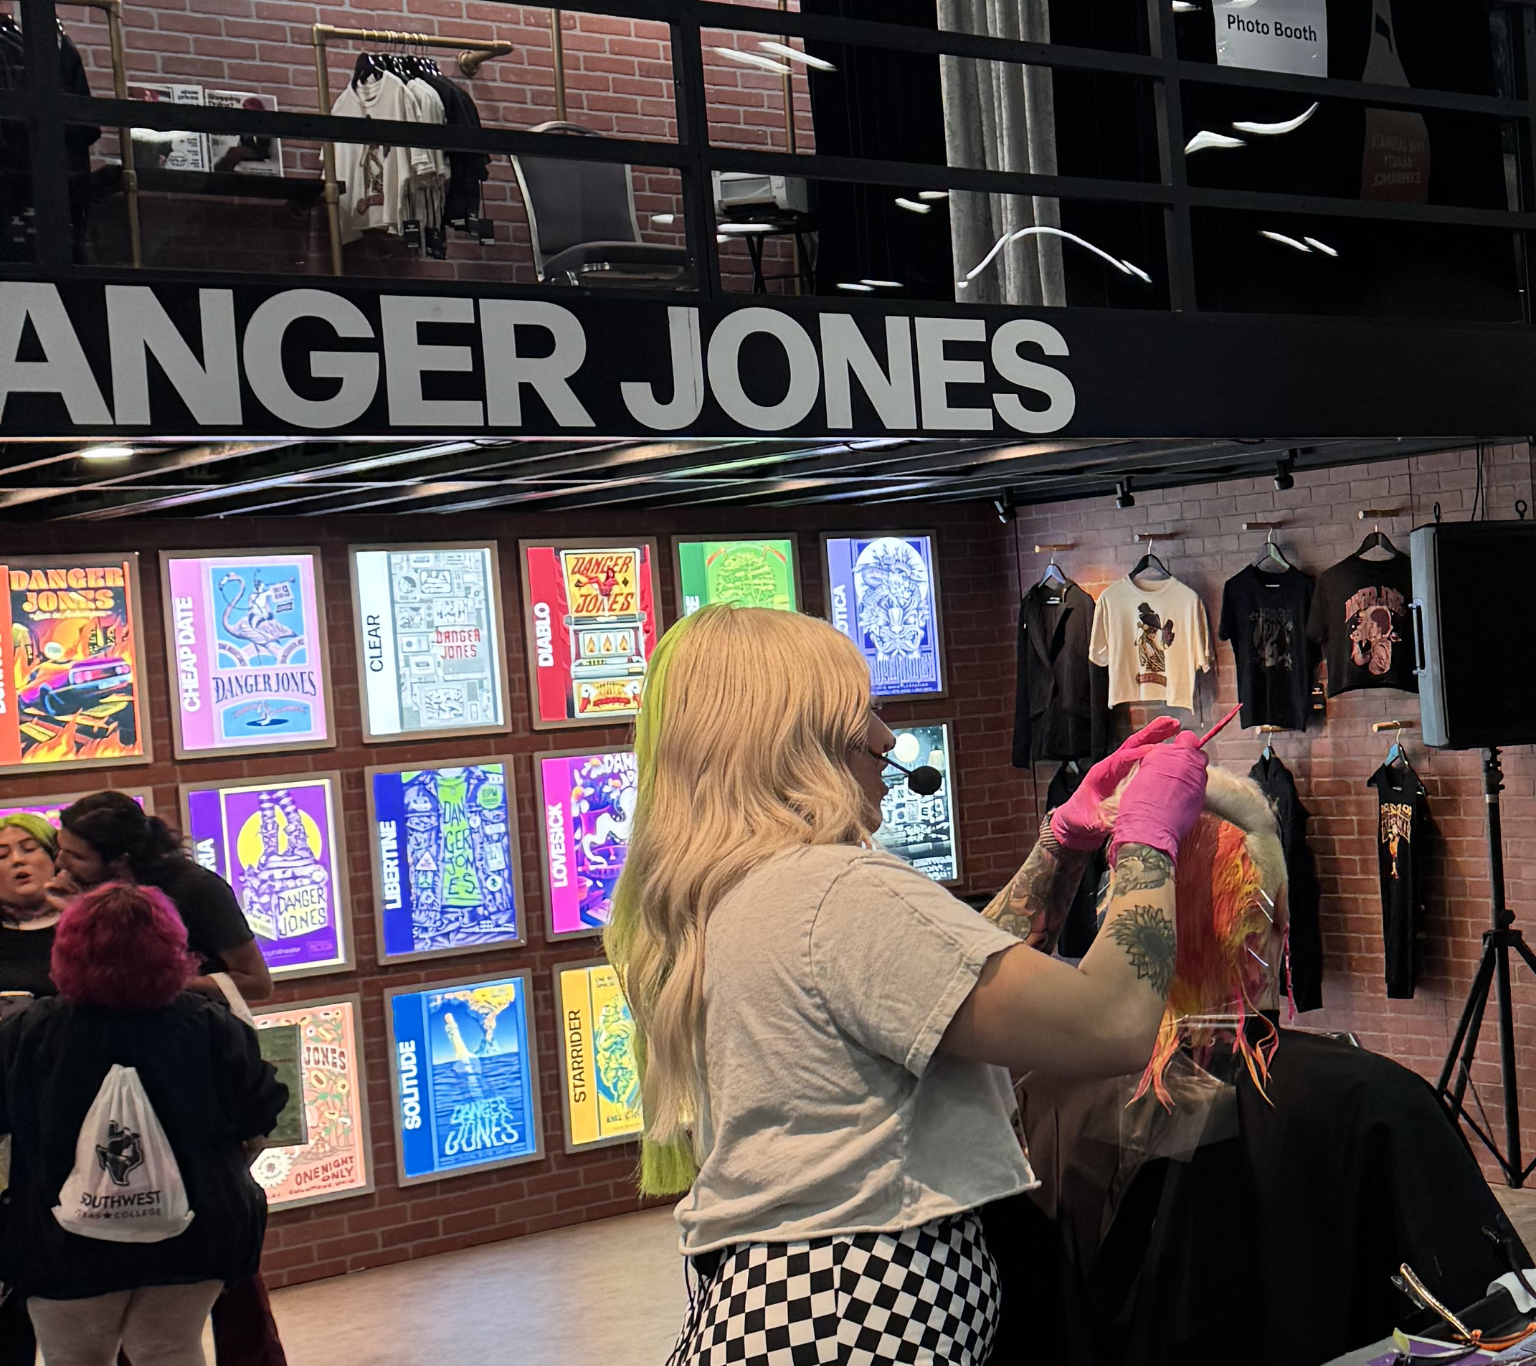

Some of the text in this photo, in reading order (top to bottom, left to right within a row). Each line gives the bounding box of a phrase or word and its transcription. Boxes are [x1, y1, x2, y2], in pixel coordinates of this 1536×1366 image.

[1227, 13, 1317, 42] Photo Booth
[620, 305, 1076, 434] JONES
[9, 567, 125, 591] DANGER
[571, 556, 632, 576] DANGER
[22, 588, 115, 613] JONES
[366, 614, 384, 672] CLEAR
[435, 628, 481, 644] DANGER
[533, 601, 554, 667] DIABLO
[175, 596, 201, 712] CHEAP DATE
[440, 644, 477, 660] JONES
[211, 671, 317, 704] DANGER JONES
[443, 800, 467, 827] DAN
[445, 829, 472, 855] GER
[548, 802, 568, 888] LOVESICK
[379, 820, 402, 910] LIBERTINE
[447, 854, 475, 876] JON
[447, 872, 476, 895] ES
[277, 886, 326, 916] DANGER
[279, 906, 327, 937] JONES
[303, 1046, 347, 1071] JONES
[568, 1009, 586, 1103] STARRIDER
[398, 1039, 421, 1130] SOLITUDE
[451, 1095, 511, 1125] DANGER
[445, 1113, 519, 1156] JONES
[295, 1167, 320, 1186] ONE
[321, 1155, 355, 1175] NIGHT
[321, 1165, 355, 1182] ONLY
[80, 1189, 161, 1209] SOUTHWEST
[114, 1207, 162, 1219] COLLEGE
